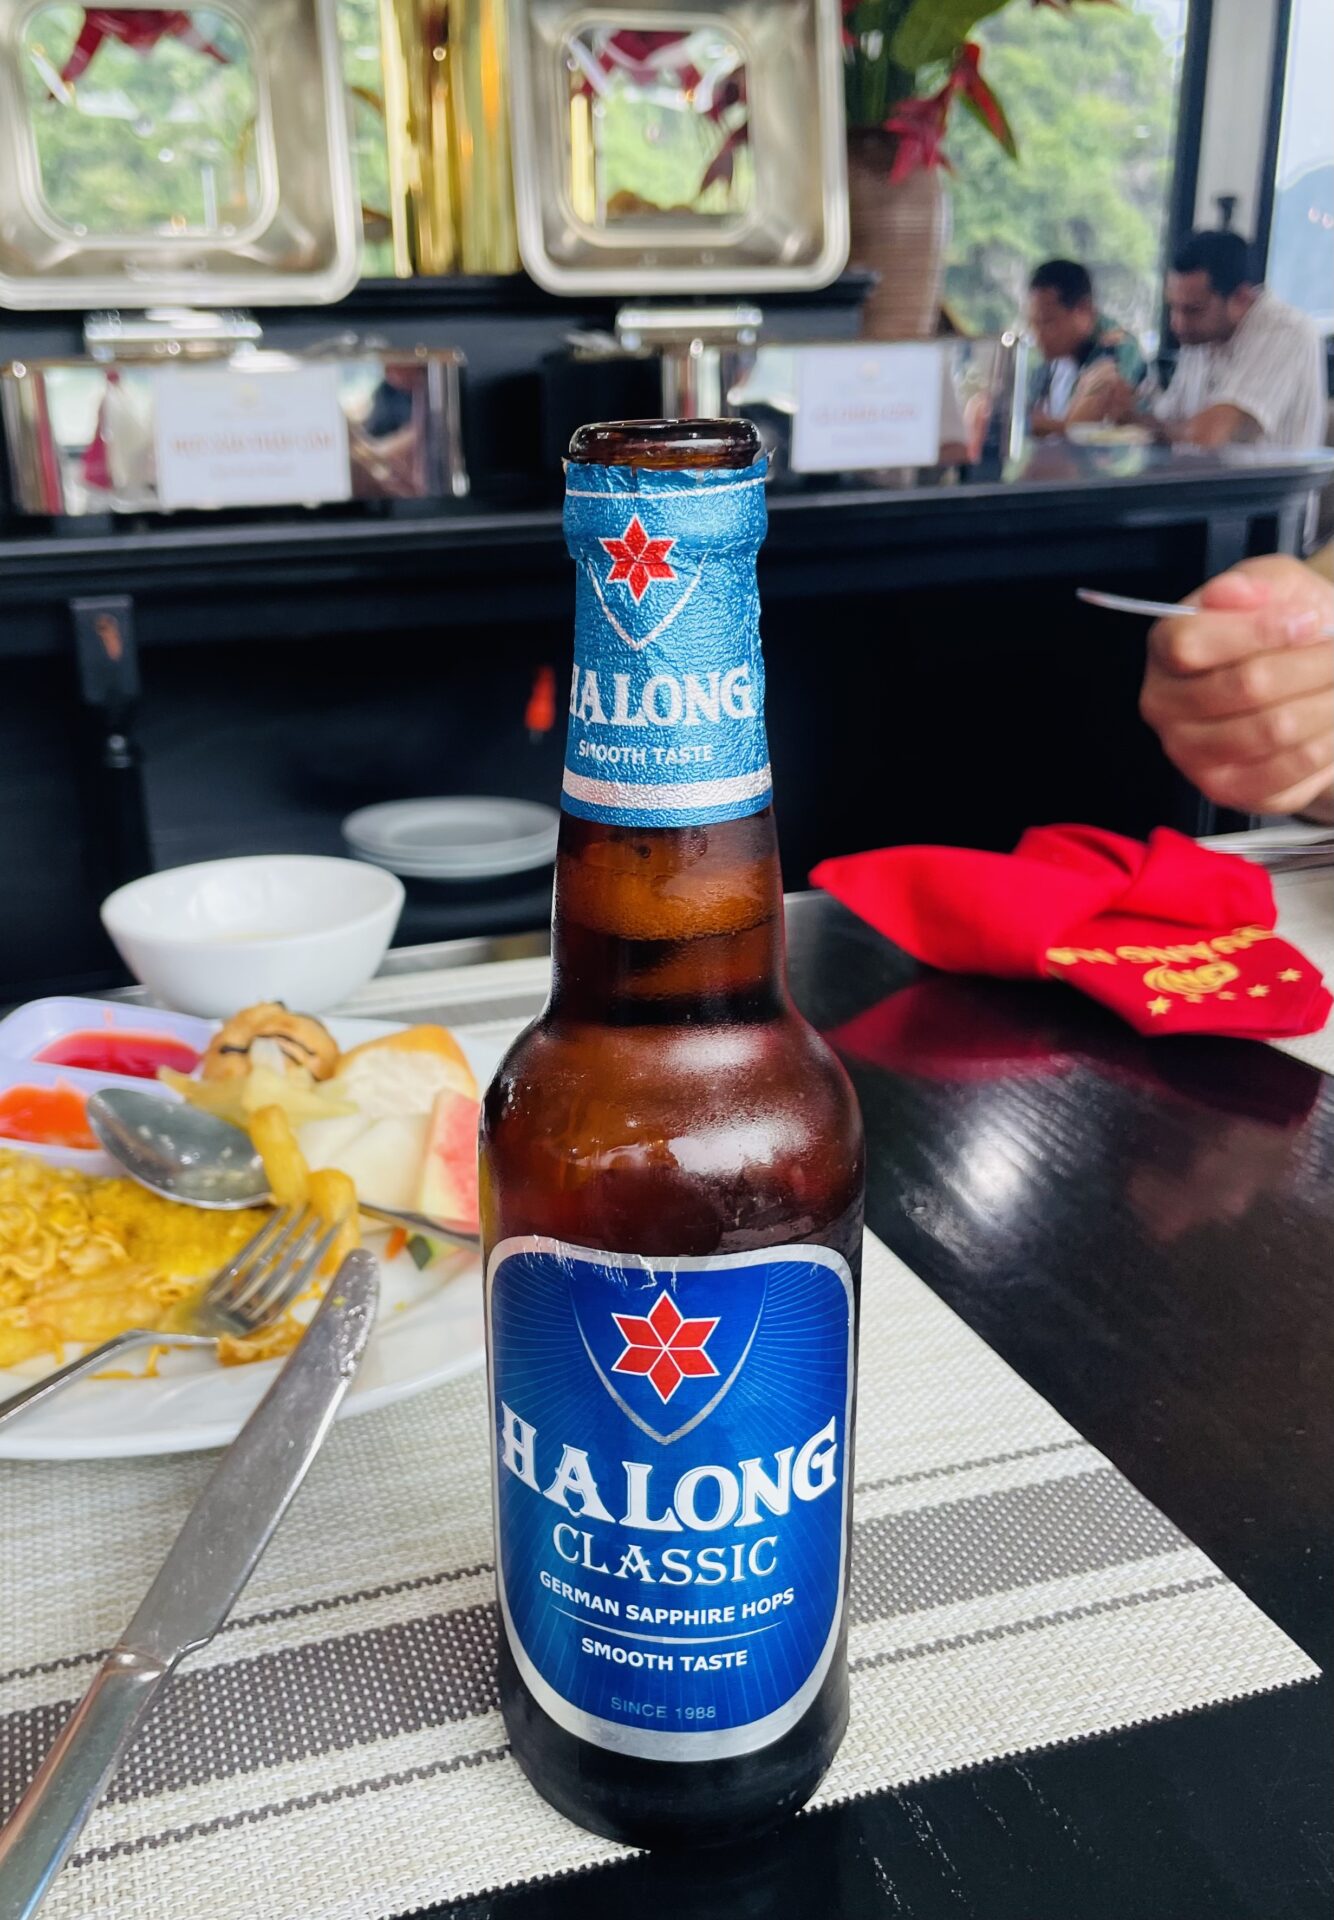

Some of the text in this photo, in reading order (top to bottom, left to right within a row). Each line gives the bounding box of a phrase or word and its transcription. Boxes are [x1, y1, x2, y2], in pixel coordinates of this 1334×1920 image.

[654, 744, 714, 765] TASTE
[501, 1401, 837, 1532] HALONG
[552, 1522, 779, 1586] CLASSIC
[539, 1570, 795, 1625] GERMAN SAPPHIRE HOPS
[581, 1637, 748, 1672] SMOOTH TASTE
[610, 1696, 717, 1721] SINCE 1988
